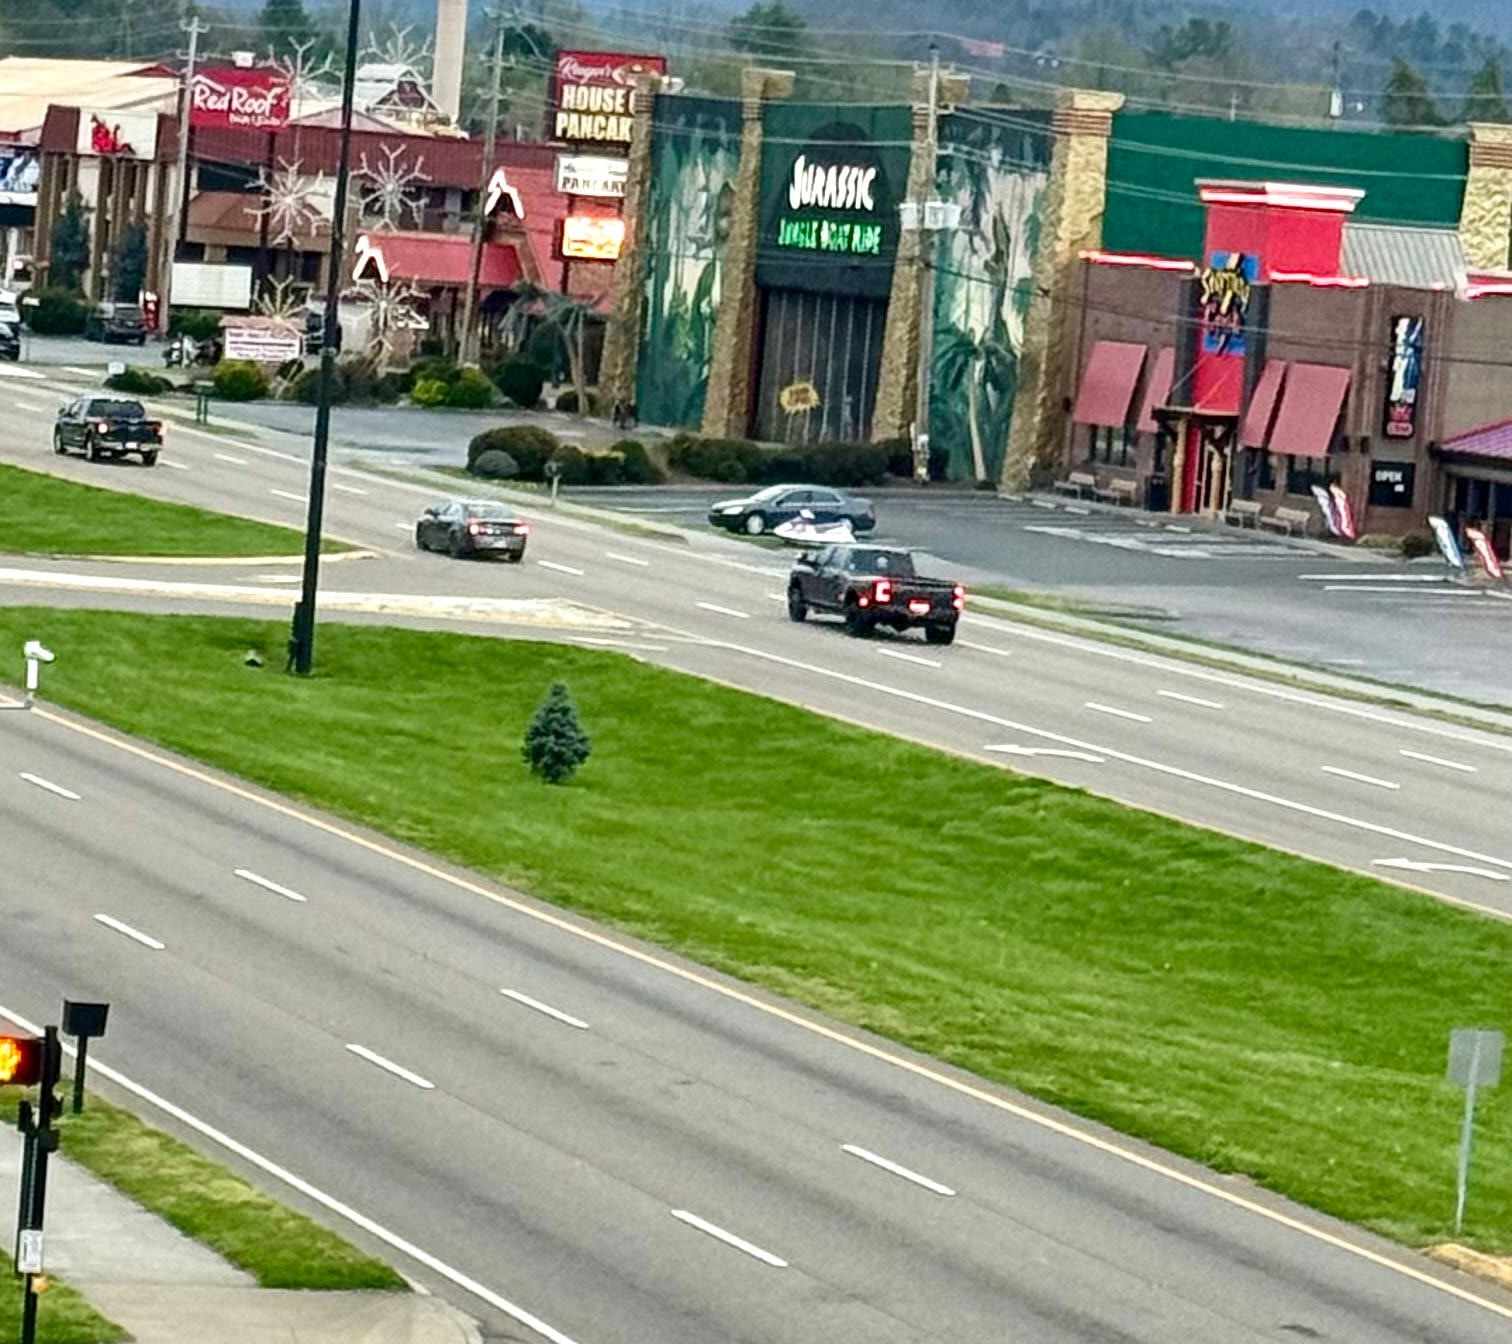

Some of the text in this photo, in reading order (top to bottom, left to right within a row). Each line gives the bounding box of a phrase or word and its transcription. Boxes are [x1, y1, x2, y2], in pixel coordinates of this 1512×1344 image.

[194, 84, 286, 117] Red Roof
[562, 84, 625, 113] HOUSE
[556, 112, 632, 141] PANCAK
[789, 154, 876, 211] JURASSIC
[852, 224, 882, 255] RIDE
